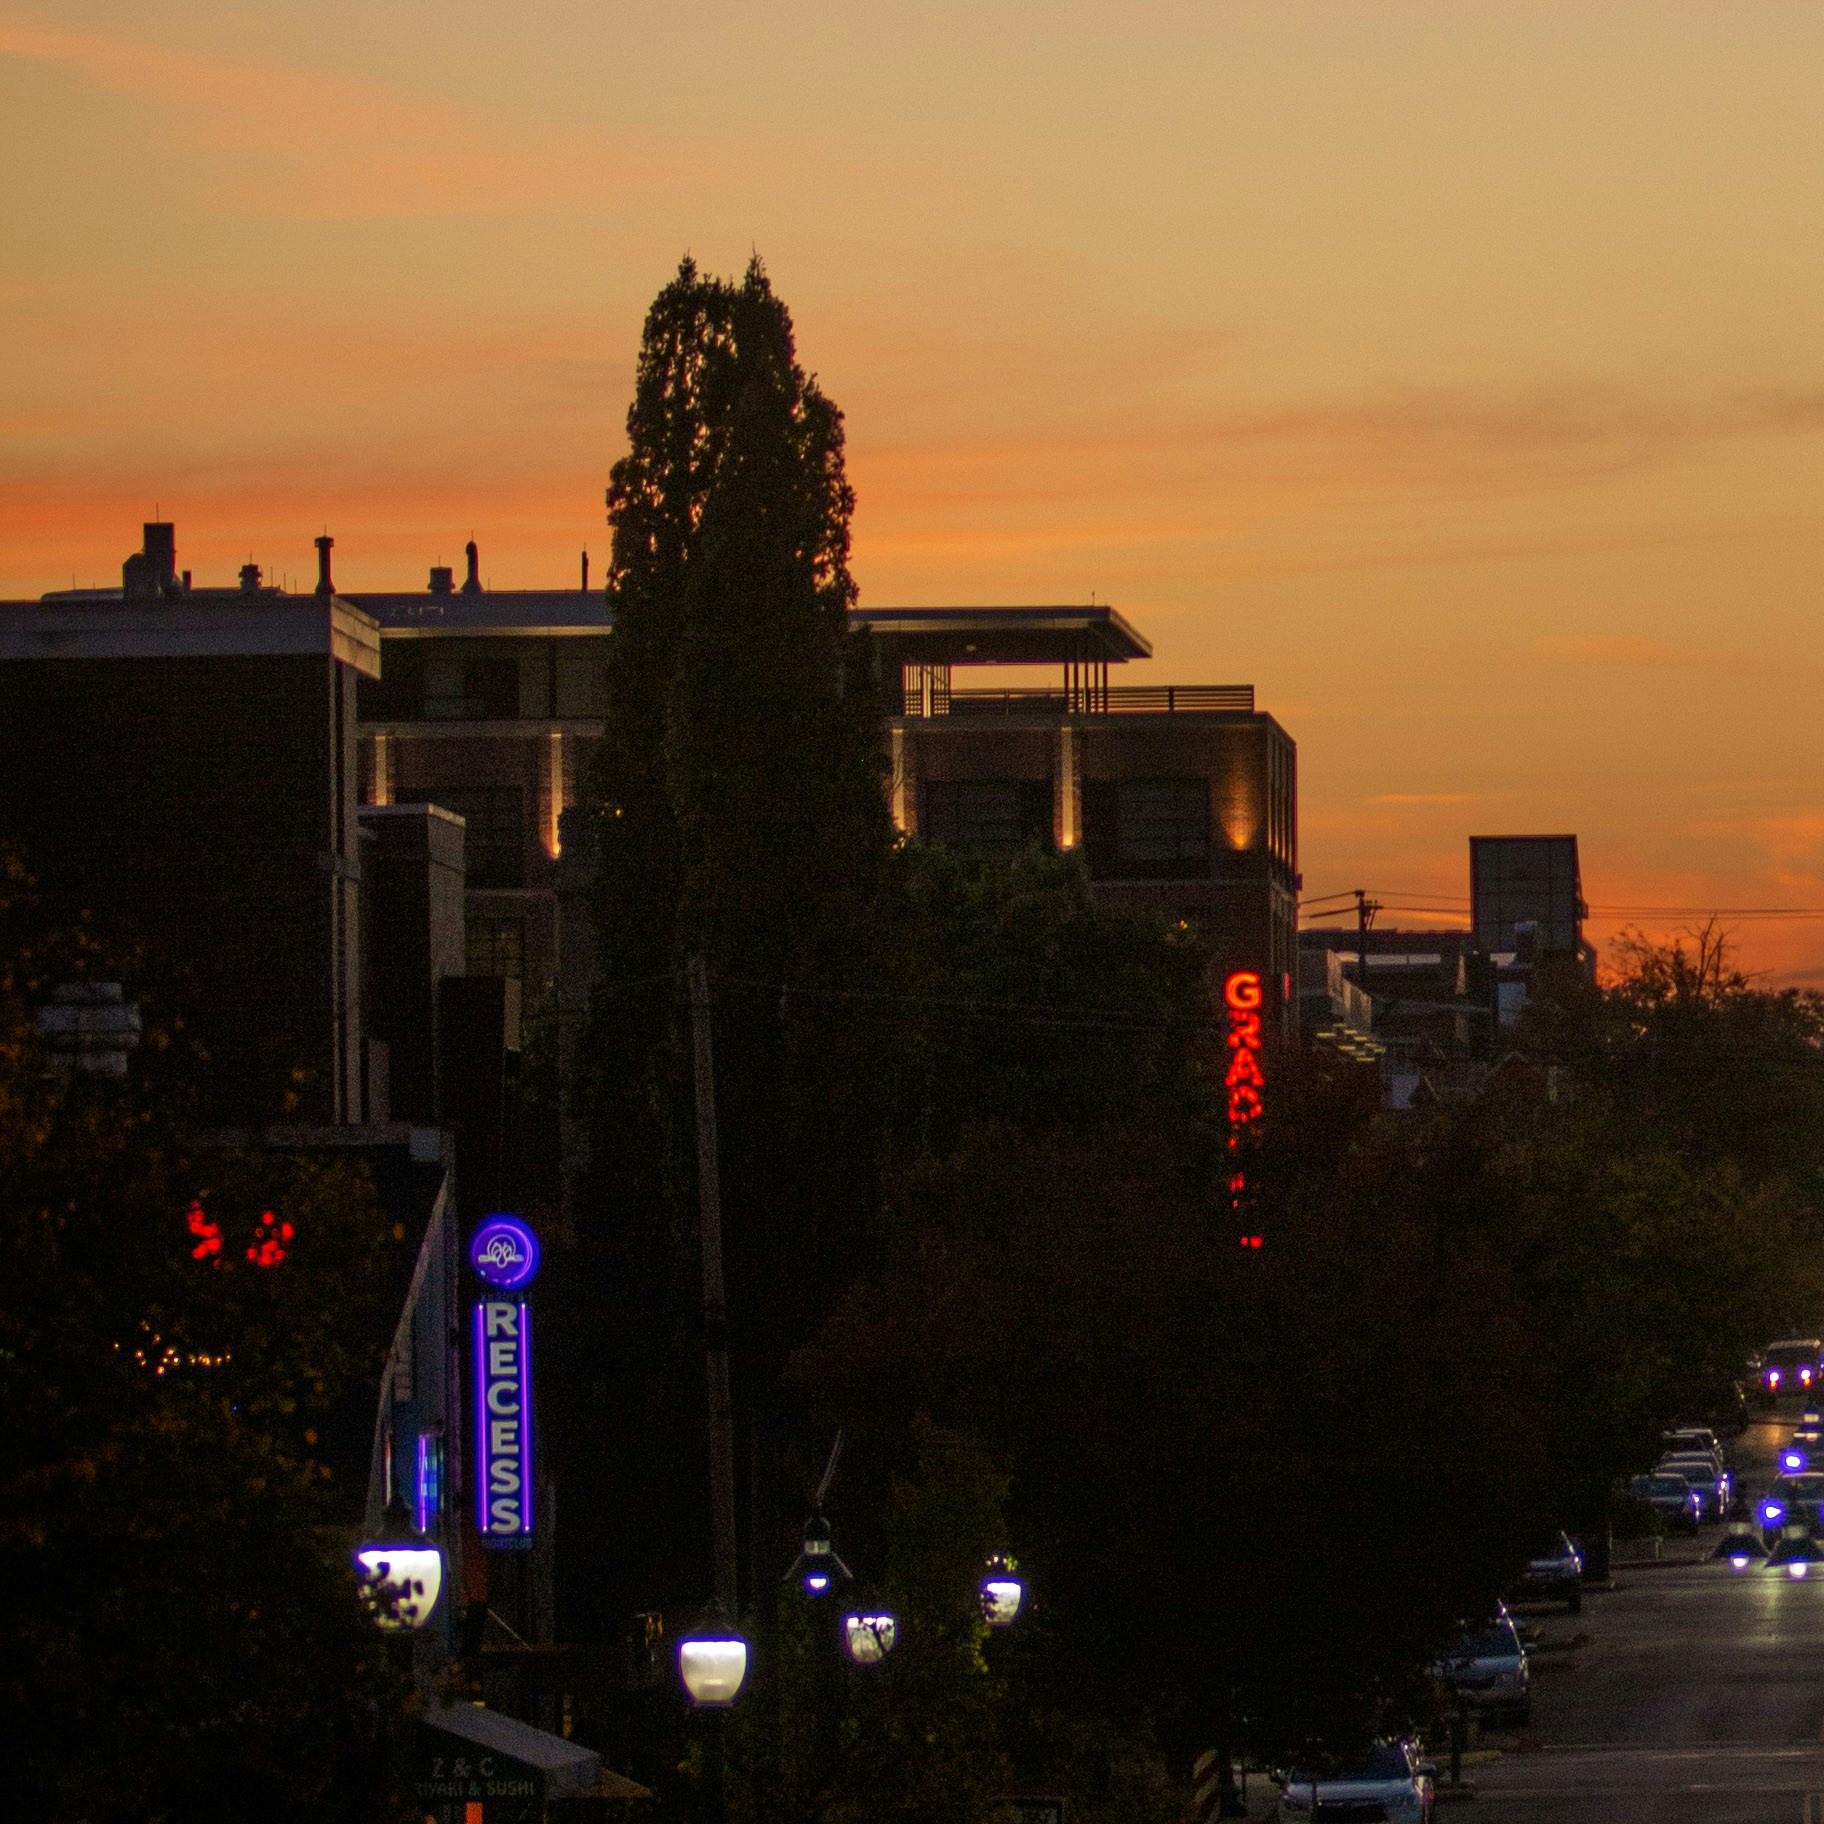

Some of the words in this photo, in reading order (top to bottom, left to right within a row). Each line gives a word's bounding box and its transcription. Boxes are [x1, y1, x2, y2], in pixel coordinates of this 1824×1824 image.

[486, 1302, 521, 1535] RECESS
[453, 1757, 472, 1778] &
[480, 1757, 494, 1777] C
[486, 1780, 534, 1797] SUSHI
